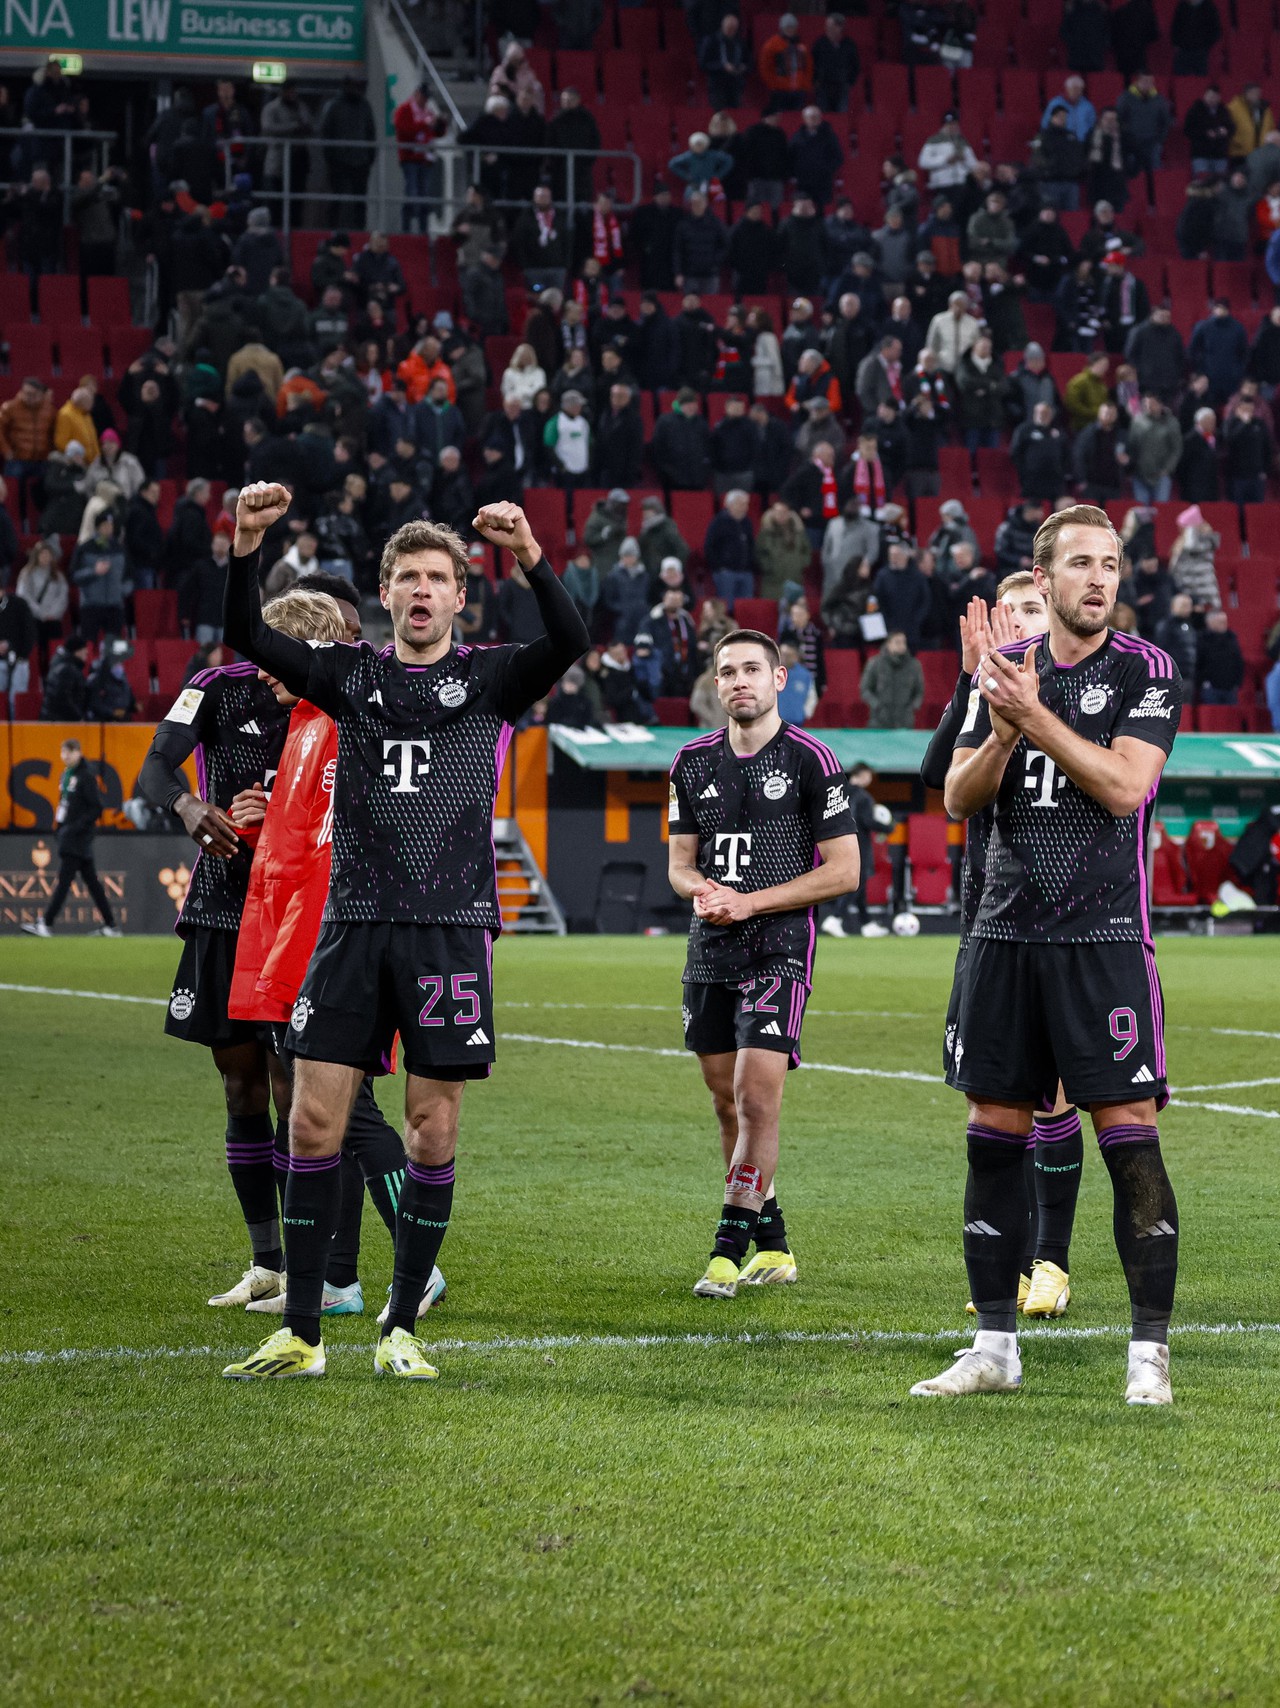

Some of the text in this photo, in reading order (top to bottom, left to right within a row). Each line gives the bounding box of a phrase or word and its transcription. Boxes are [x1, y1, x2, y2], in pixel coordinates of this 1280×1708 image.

[107, 0, 354, 43] LEW Business Club
[1145, 686, 1169, 700] ROT
[383, 740, 430, 792] T
[715, 833, 751, 881] T
[417, 972, 481, 1027] 25
[737, 976, 782, 1014] 22
[1108, 1006, 1139, 1061] 9
[1043, 1162, 1080, 1173] BAYERN
[402, 1211, 414, 1222] FC
